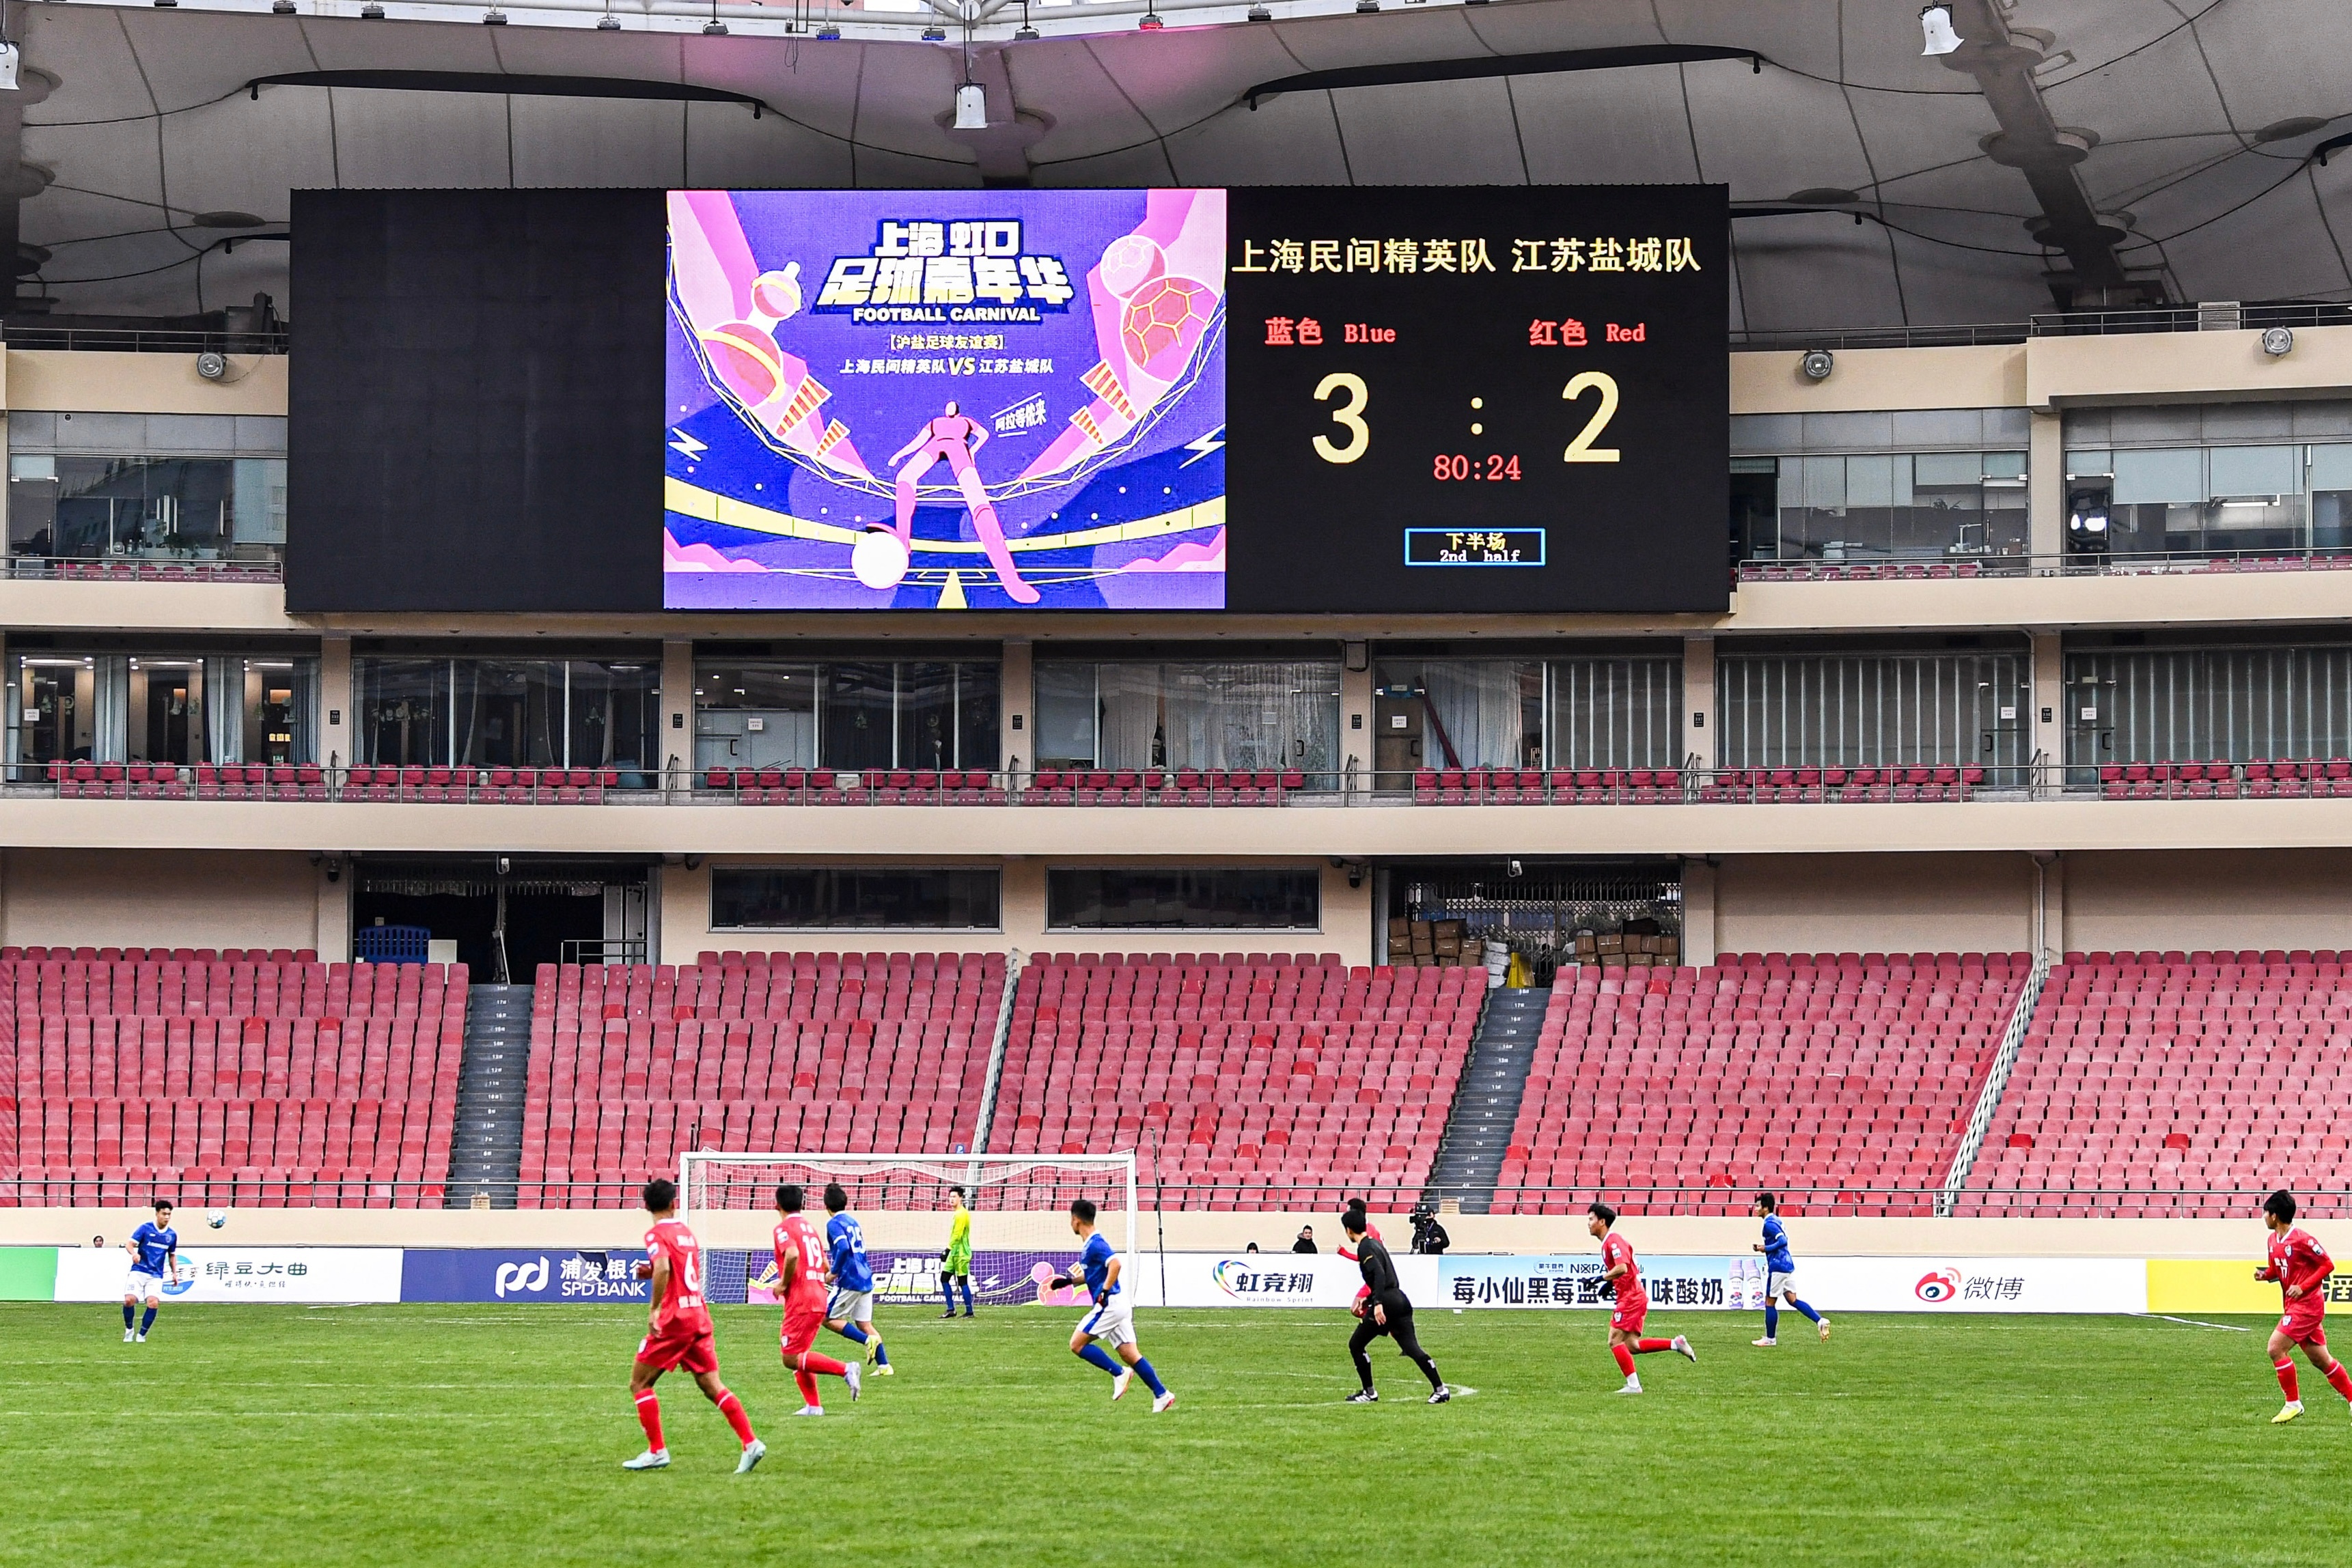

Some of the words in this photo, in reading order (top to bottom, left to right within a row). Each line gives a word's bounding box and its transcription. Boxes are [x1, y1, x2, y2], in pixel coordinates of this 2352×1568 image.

[874, 221, 944, 257] 上海
[950, 221, 1020, 257] 虹口
[1231, 237, 1496, 274] 上海民间精英队
[1511, 237, 1702, 273] 江苏盐城队
[816, 255, 1075, 305] 足球嘉年华
[853, 307, 947, 322] FOOTBALL
[950, 307, 1041, 322] CARNIVAL
[1264, 316, 1323, 345] 蓝色
[1344, 323, 1396, 343] Blue
[1529, 318, 1588, 346] 红色
[1606, 322, 1646, 342] Red
[840, 358, 945, 374] 上海民间精英队
[947, 356, 976, 376] VS
[978, 358, 1054, 374] 江苏盐城队
[1312, 372, 1370, 464] 3
[1562, 371, 1620, 463] 2
[1433, 454, 1521, 480] 80:24
[1445, 533, 1506, 550] 下半场
[1439, 550, 1467, 563] 2nd
[1484, 550, 1521, 563] half
[803, 1235, 822, 1268] 19
[846, 1225, 866, 1254] 25
[206, 1262, 307, 1280] 绿豆大曲
[684, 1251, 698, 1291] 6
[891, 1258, 922, 1273] 上海
[562, 1281, 594, 1296] SPD
[598, 1282, 646, 1296] BANK
[1235, 1273, 1314, 1293] 虹竞翔
[1453, 1276, 1723, 1305] 莓小仙黑莓蓝味酸奶
[1964, 1276, 2025, 1300] 微博
[879, 1294, 922, 1302] FOOTBALL
[923, 1294, 965, 1302] CARNVAL
